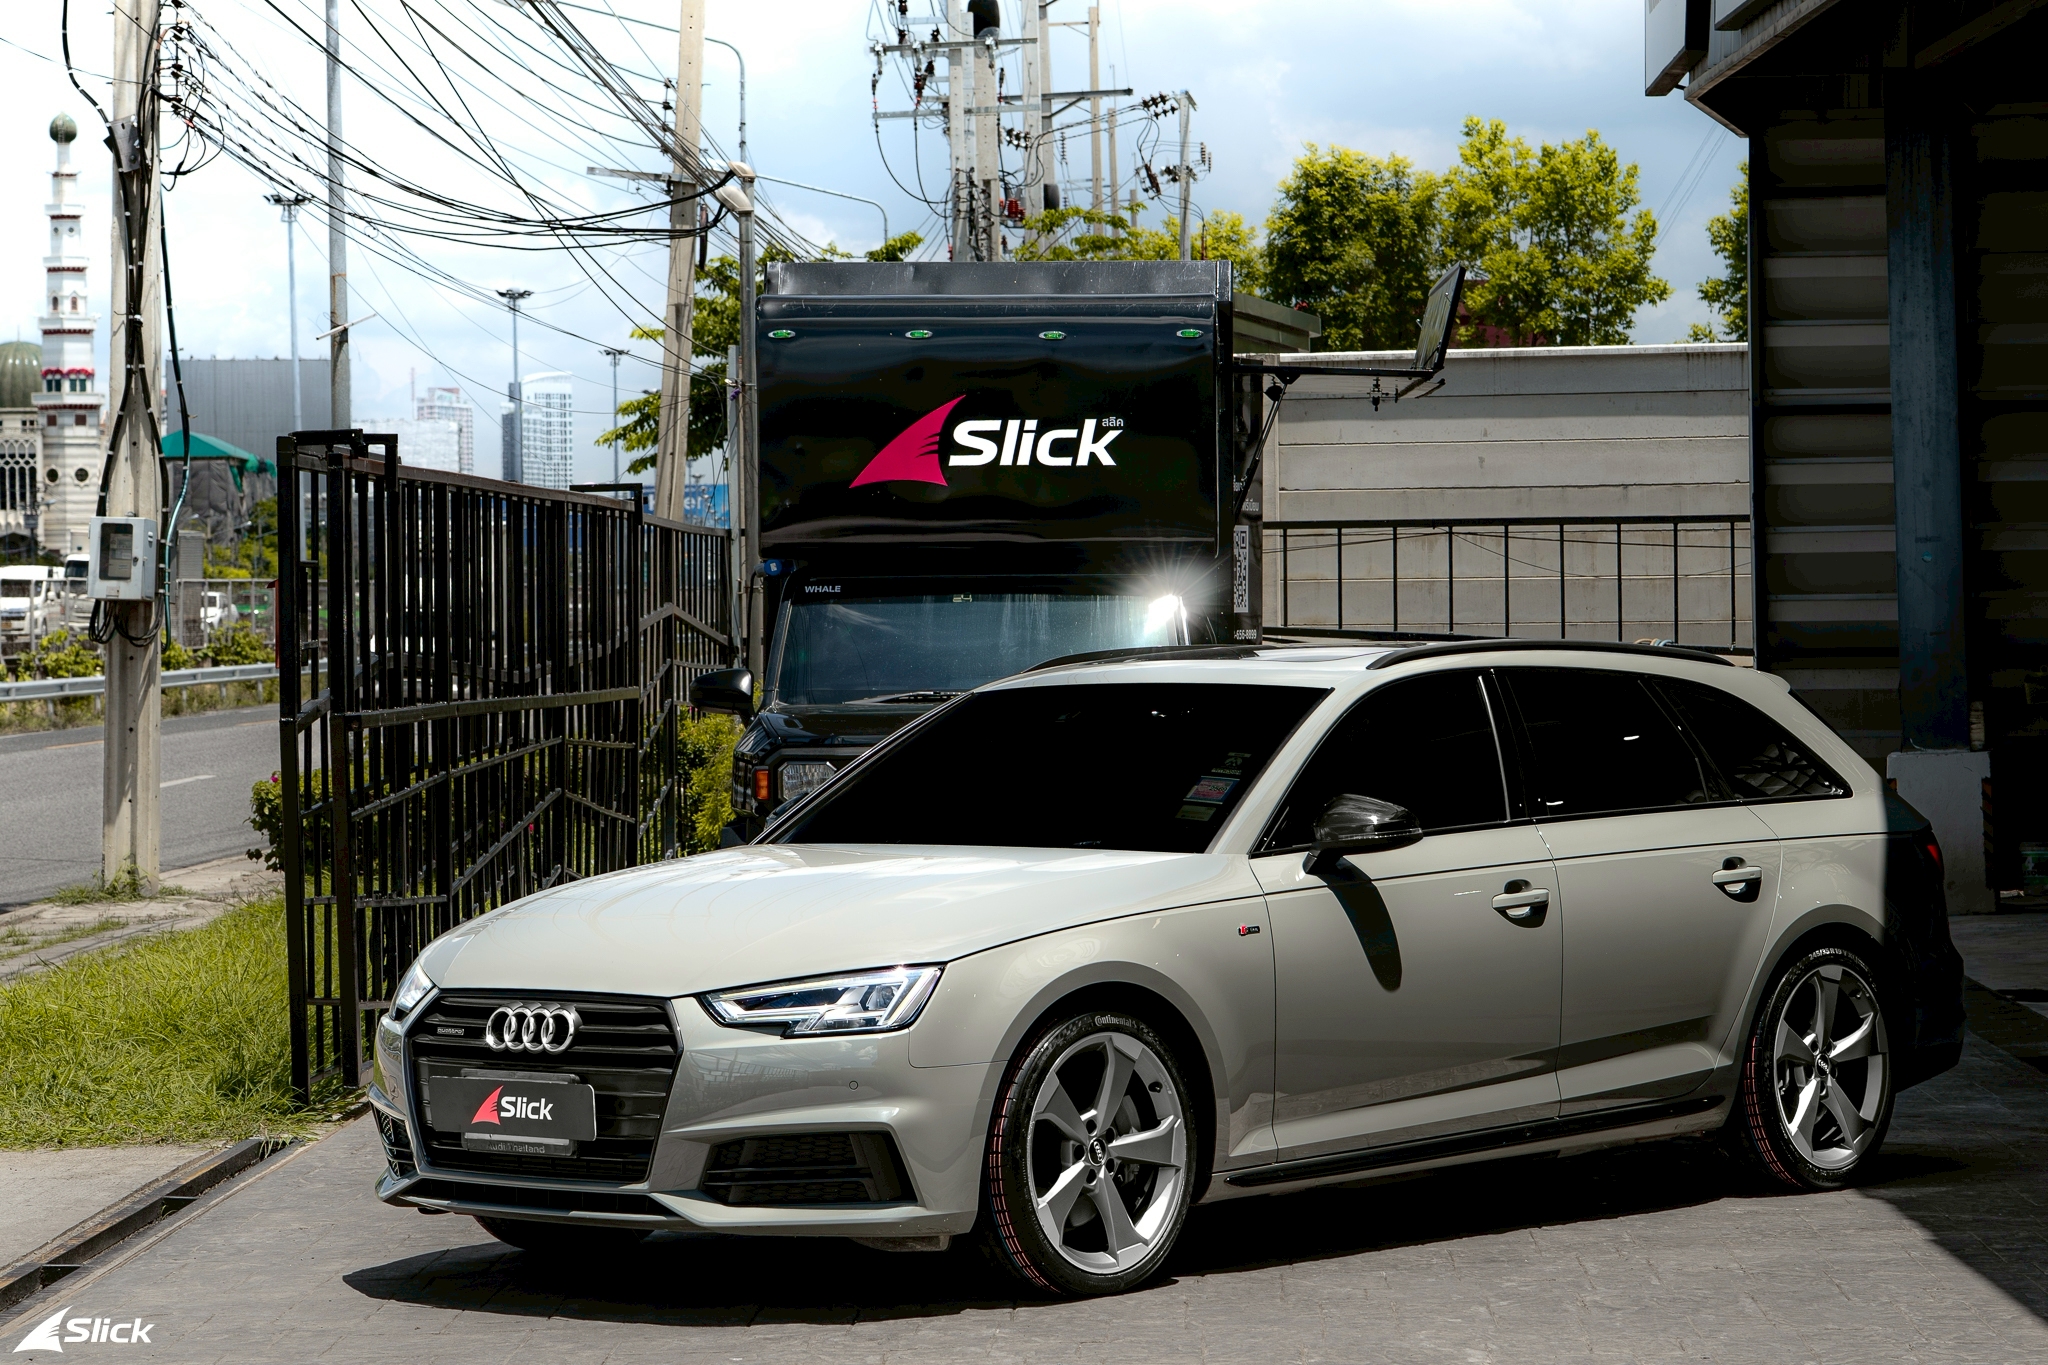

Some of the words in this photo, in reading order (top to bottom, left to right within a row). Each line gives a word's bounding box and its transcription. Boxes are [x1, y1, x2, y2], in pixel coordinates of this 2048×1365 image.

[948, 419, 1123, 466] Slick
[804, 585, 841, 593] WHALE
[1094, 1014, 1132, 1028] Continental
[500, 1096, 553, 1121] Slick
